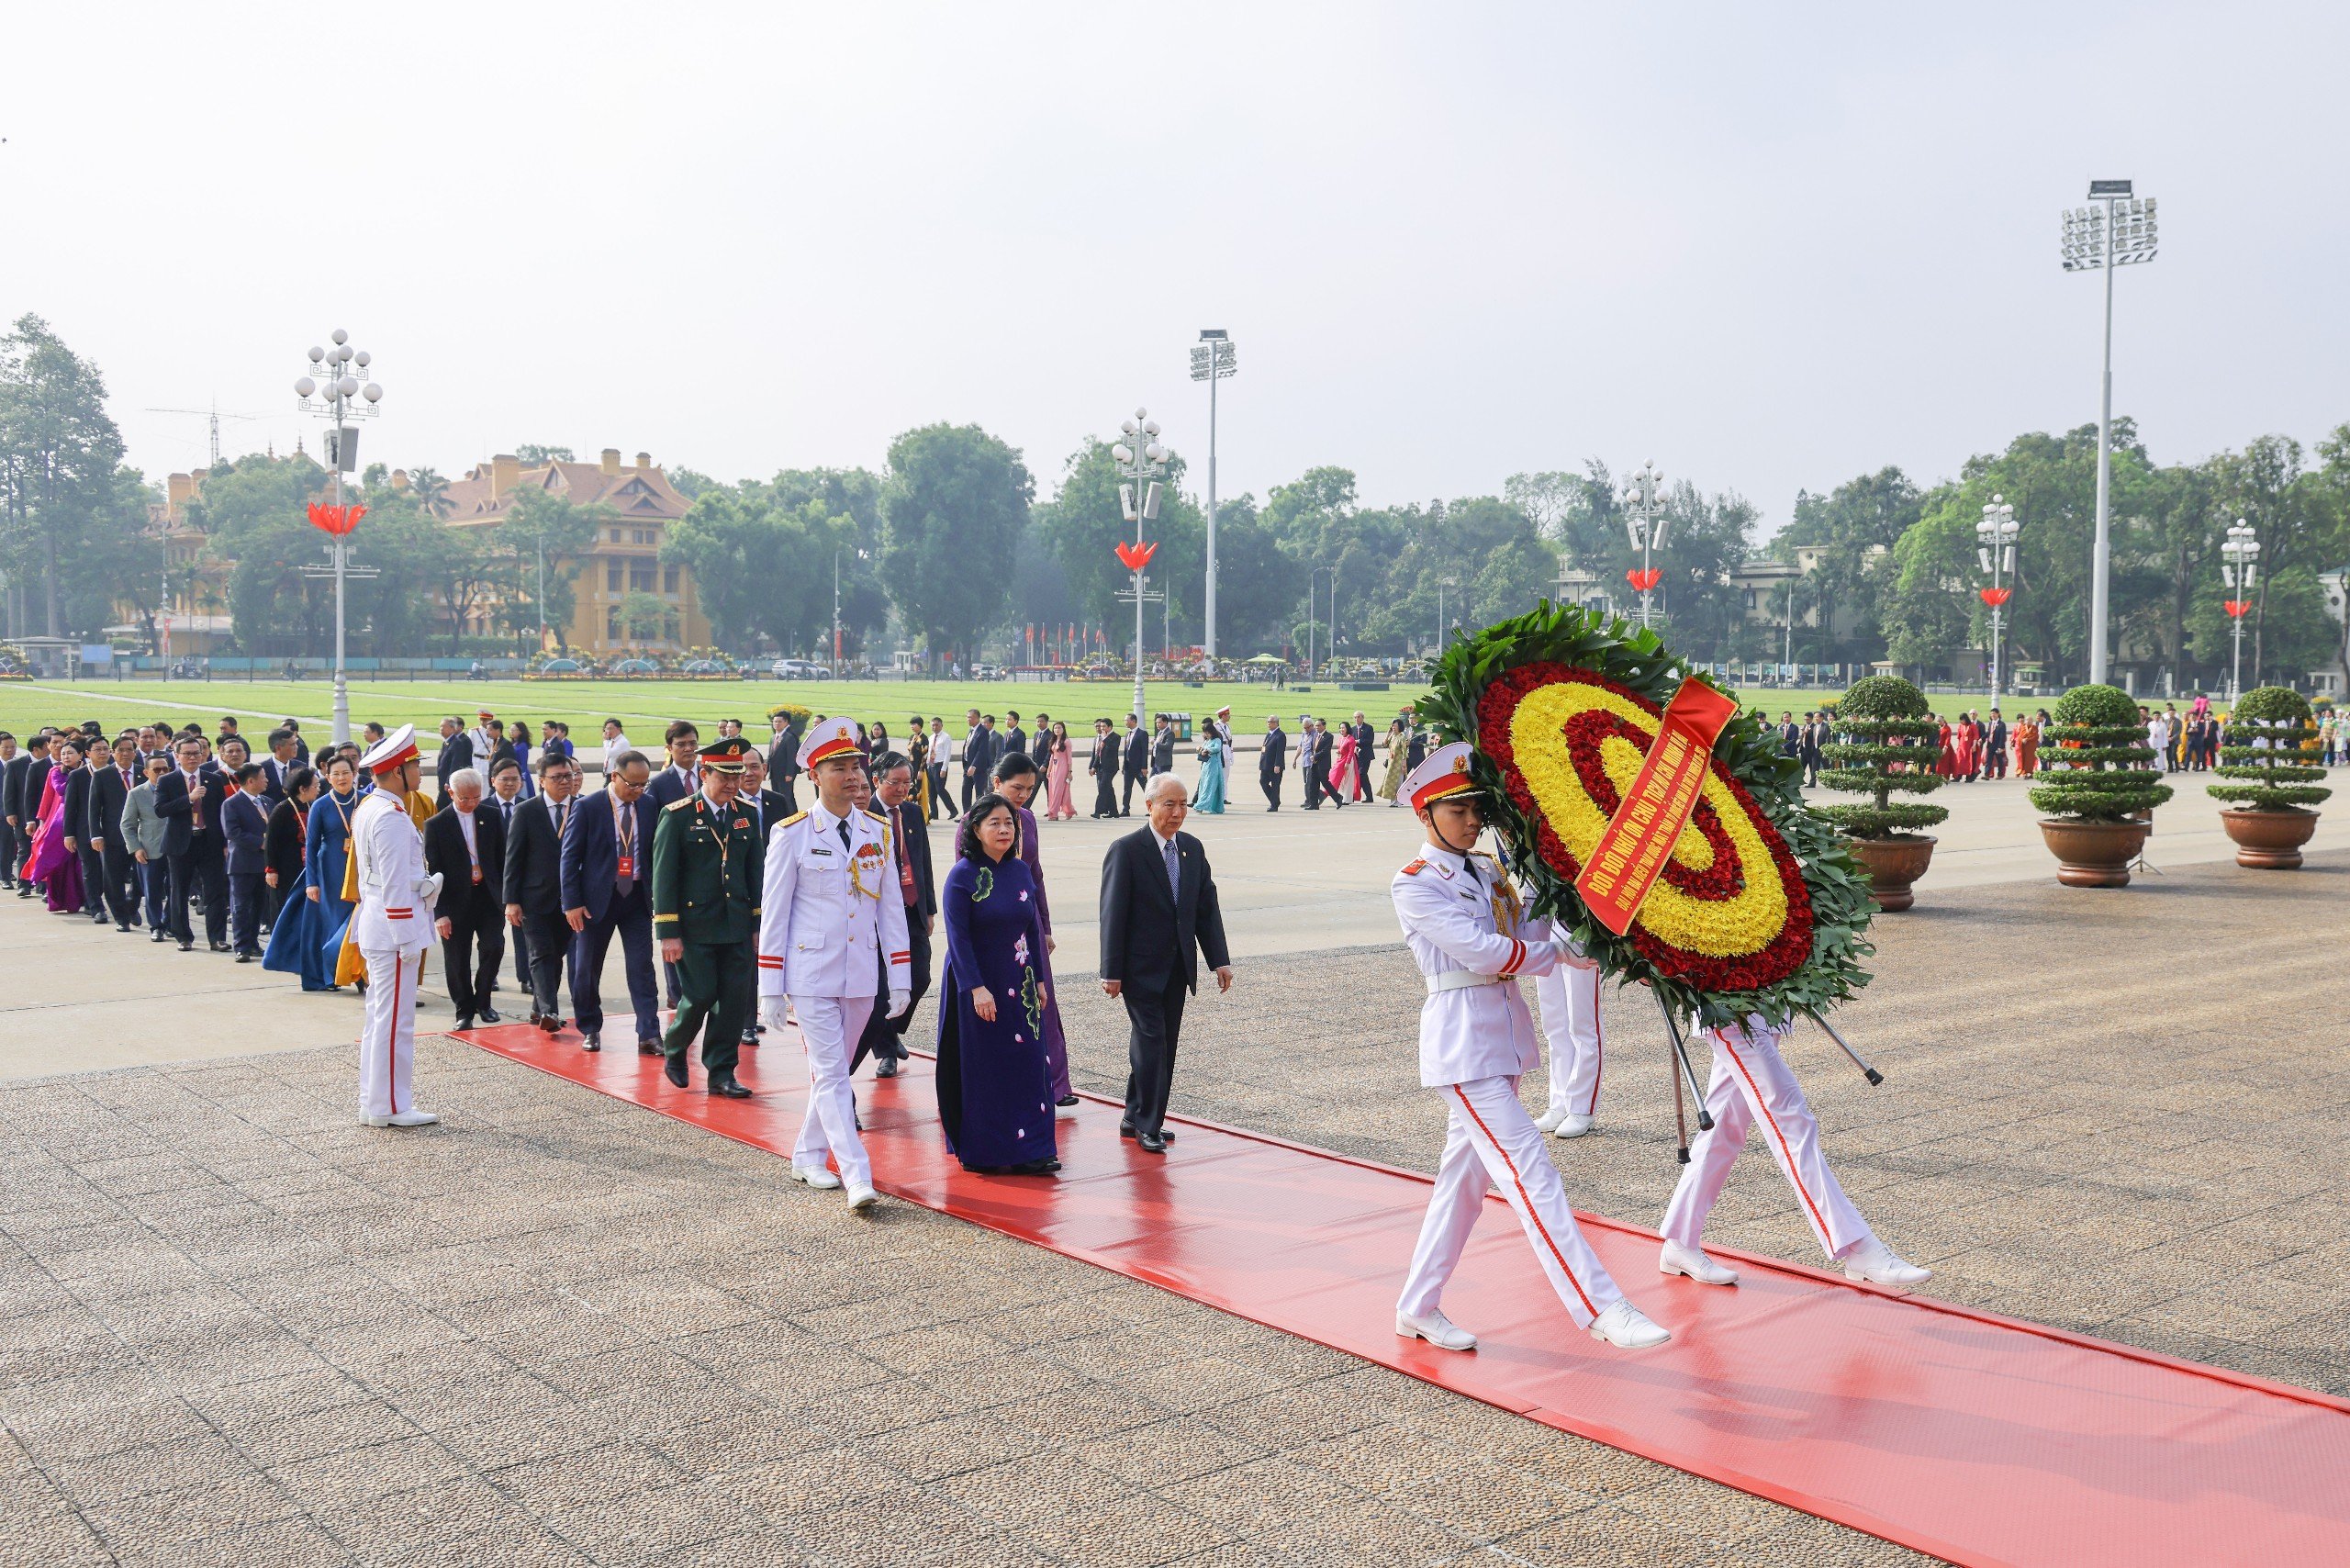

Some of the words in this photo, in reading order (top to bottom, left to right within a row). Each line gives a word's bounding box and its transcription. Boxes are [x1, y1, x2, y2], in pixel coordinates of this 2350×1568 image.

[1661, 742, 1684, 768] MINH
[1650, 767, 1670, 790] HỒ
[1655, 756, 1676, 780] CHÍ
[1642, 779, 1669, 804] TỊCH
[1630, 795, 1658, 824] CHỦ
[1622, 818, 1646, 838] ƠN
[1610, 829, 1638, 858] NHỚ
[1599, 850, 1627, 877] ĐỜI
[1630, 863, 1650, 882] BIỂU
[1587, 870, 1616, 897] ĐỜI
[1621, 884, 1639, 901] HỘI
[1615, 895, 1632, 912] ĐẠI
